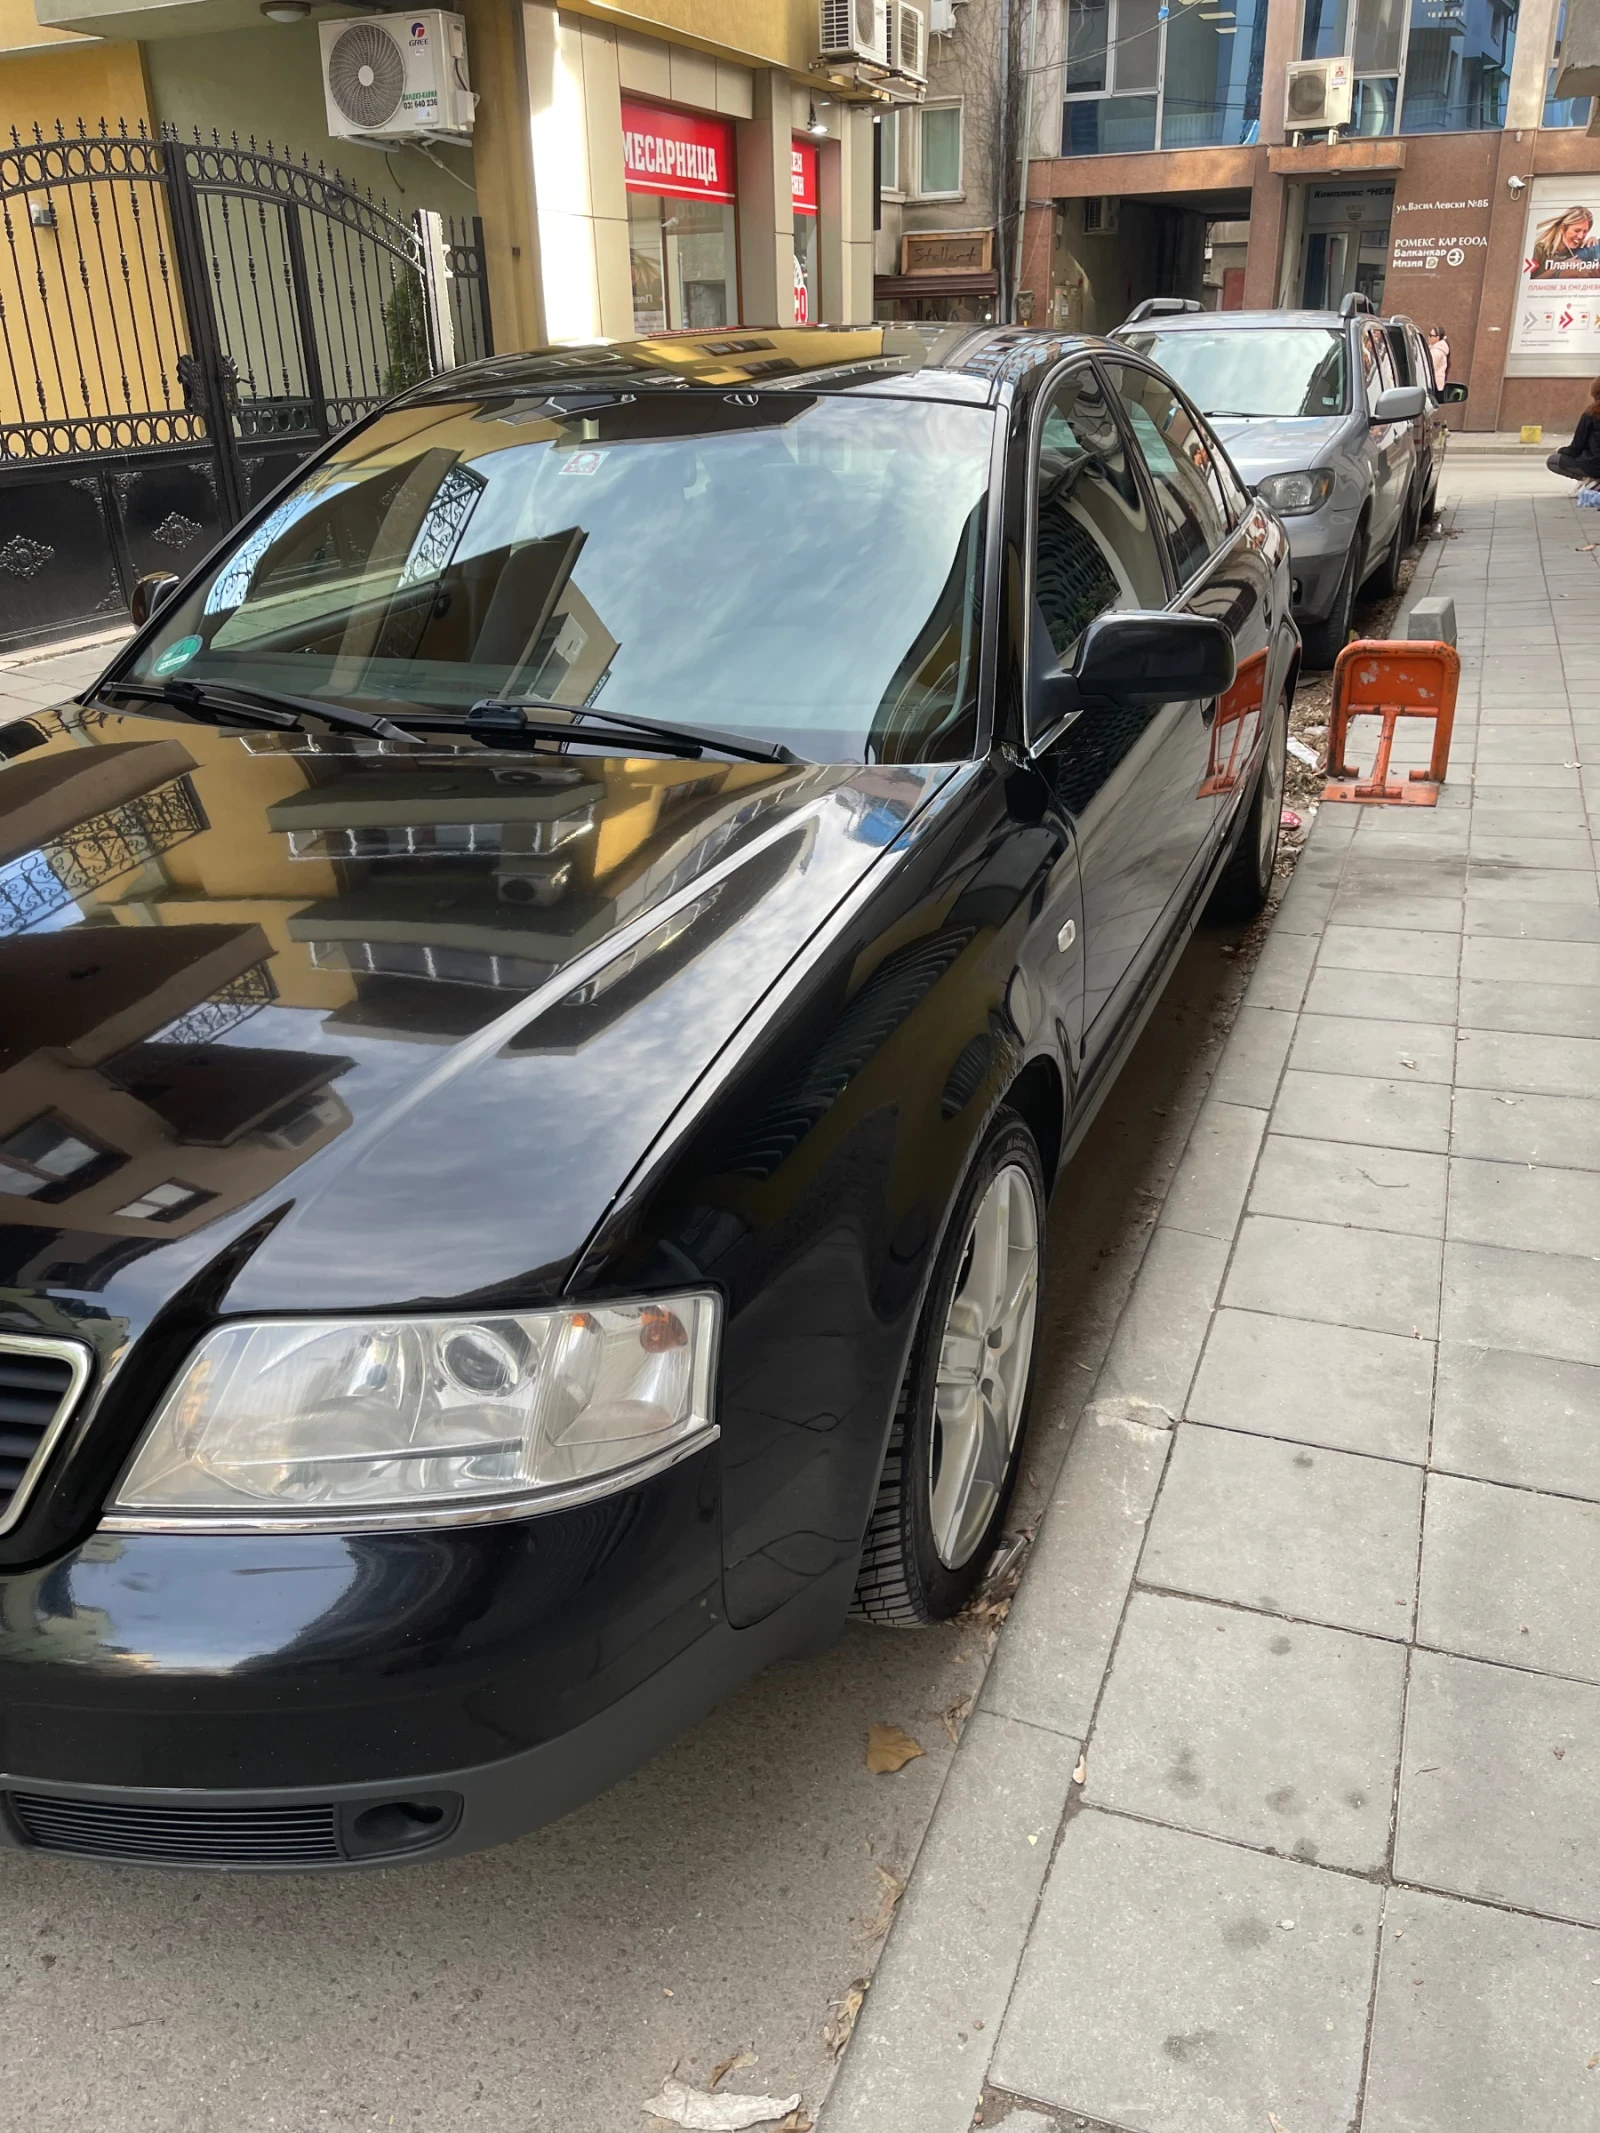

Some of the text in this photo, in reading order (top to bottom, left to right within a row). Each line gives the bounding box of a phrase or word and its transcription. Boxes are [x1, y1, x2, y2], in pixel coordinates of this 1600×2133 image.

[409, 38, 428, 46] GREE
[623, 131, 718, 186] МЕСАРНИЦА
[1434, 201, 1466, 209] Левски
[1395, 237, 1488, 248] РОМЕКС КАР ЕООД
[1394, 249, 1447, 258] Балканкар
[1392, 259, 1424, 268] Мизия
[1545, 259, 1599, 271] Планирай
